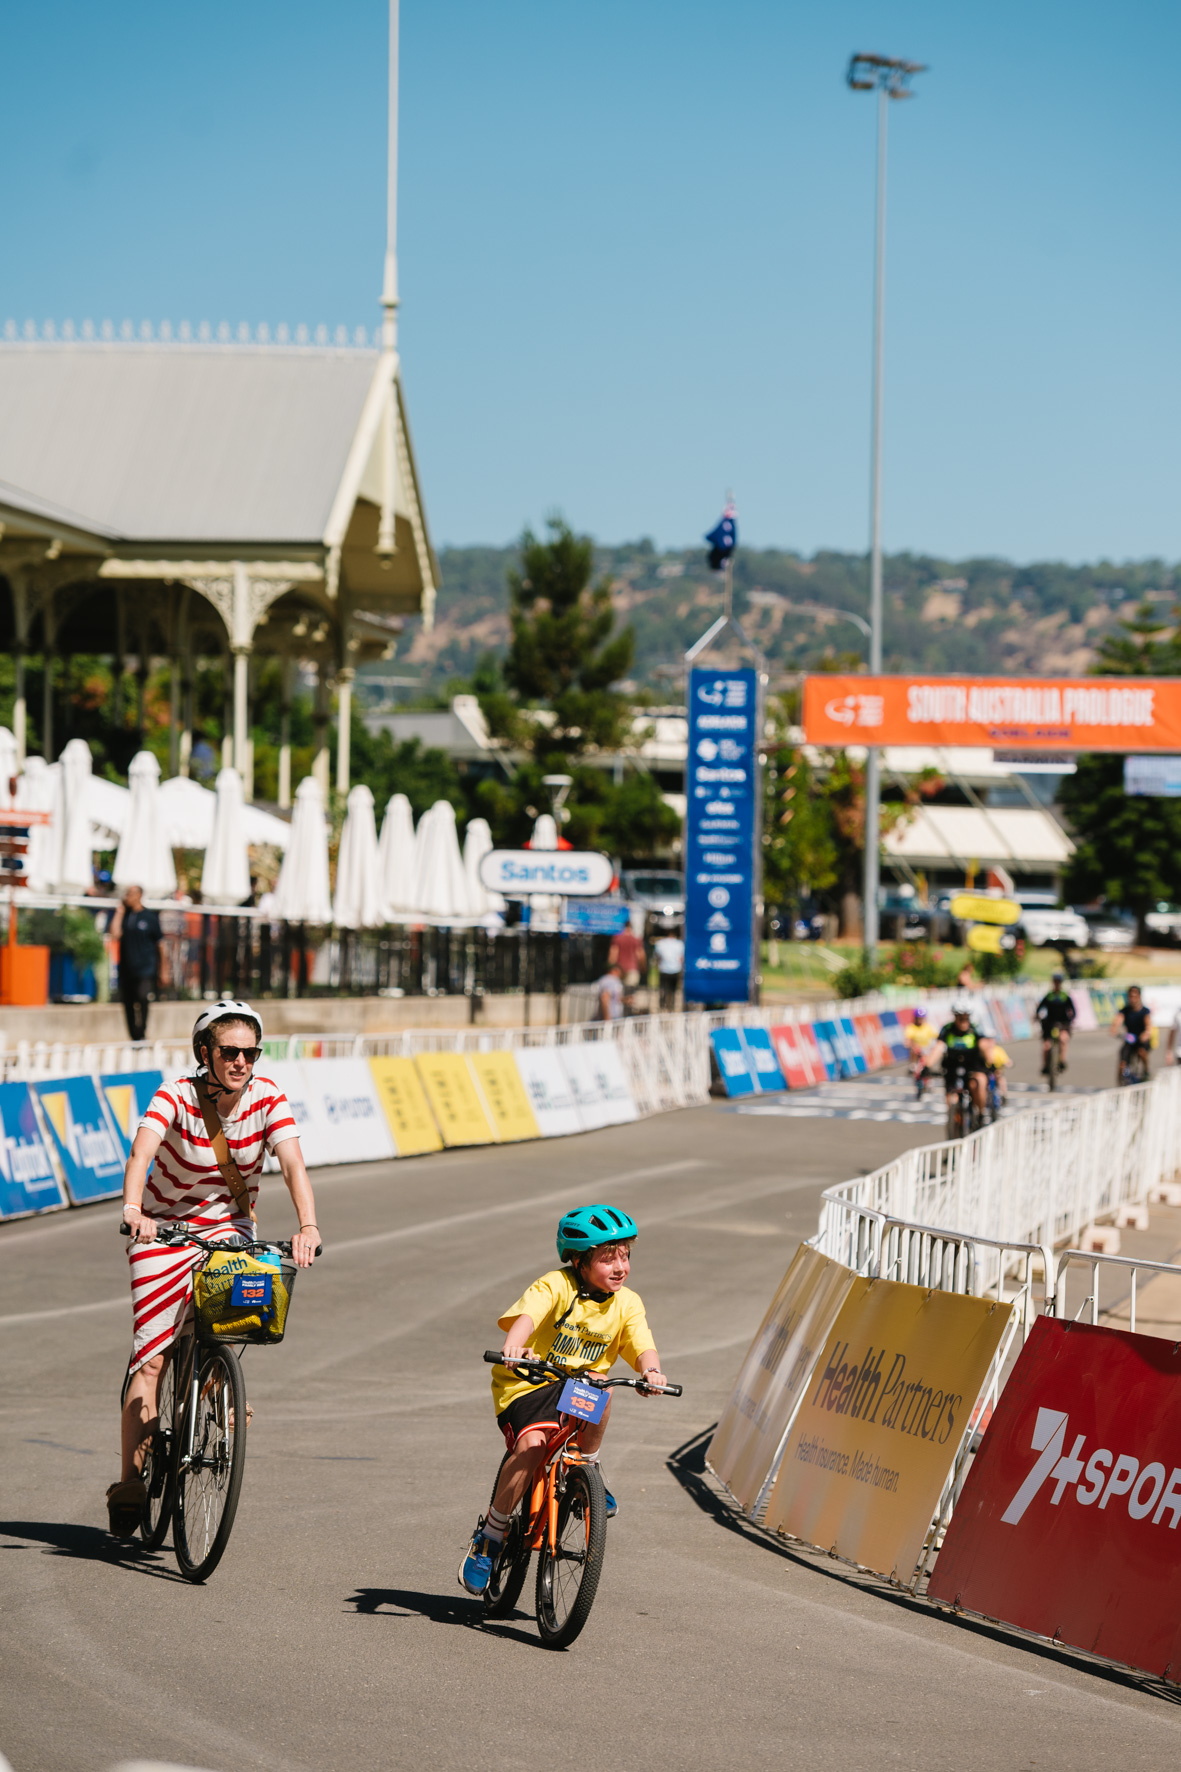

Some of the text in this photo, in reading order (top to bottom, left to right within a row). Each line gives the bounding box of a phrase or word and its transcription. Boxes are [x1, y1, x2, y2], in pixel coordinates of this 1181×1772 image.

[907, 685, 967, 723] SOUTH
[968, 686, 1061, 725] AUSTRALIA
[1063, 687, 1155, 726] PROLOGUE
[501, 860, 590, 882] Santos
[204, 1257, 248, 1281] Health
[242, 1289, 265, 1298] 132
[580, 1326, 612, 1340] Partners
[571, 1396, 596, 1412] 133
[812, 1341, 886, 1421] Health
[867, 1353, 963, 1445] Partners
[795, 1432, 900, 1494] Health insurance. Made human.
